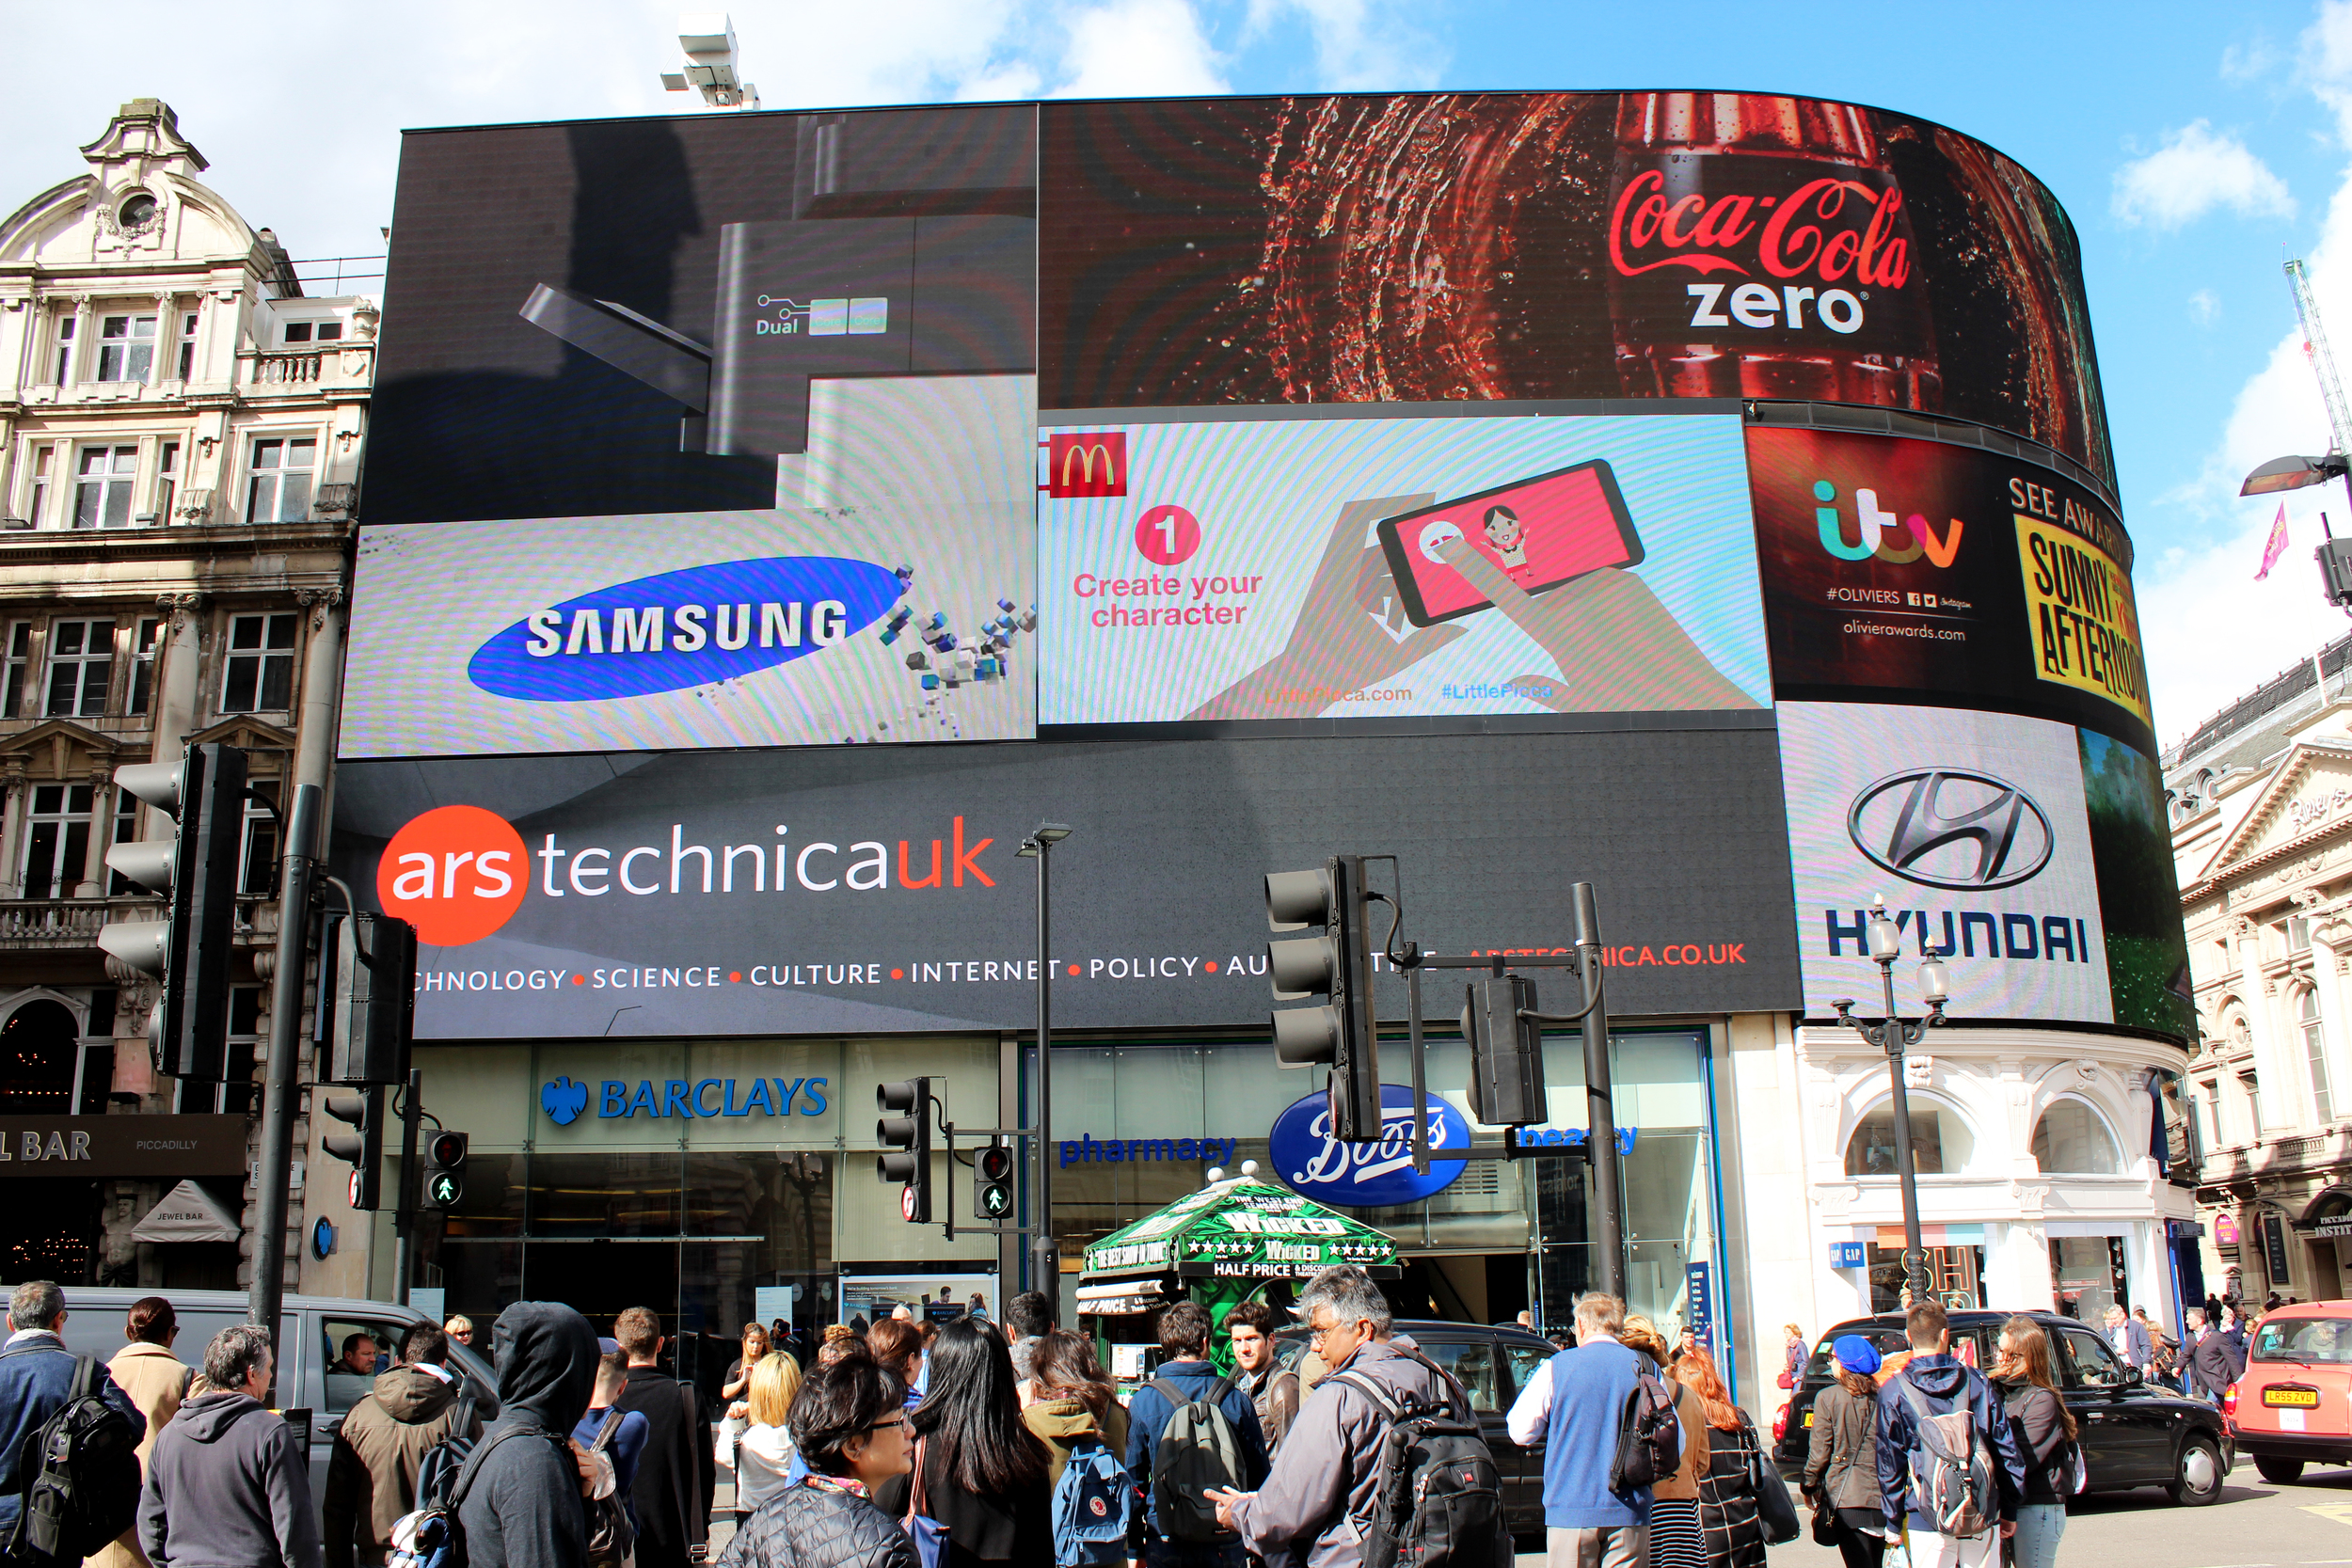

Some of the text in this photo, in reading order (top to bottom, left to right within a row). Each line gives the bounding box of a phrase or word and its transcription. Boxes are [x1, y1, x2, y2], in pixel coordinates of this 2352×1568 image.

[1610, 168, 1910, 290] Coca-Cola
[1687, 283, 1864, 334] zero
[756, 318, 798, 335] Dual
[2009, 477, 2058, 519] SEE
[1154, 515, 1176, 554] 1
[1814, 480, 1963, 568] itv
[1073, 572, 1263, 602] Create your
[2028, 531, 2113, 624] SUNNY
[1826, 587, 1900, 605] #OLIVIERS
[525, 599, 847, 657] SAMSUNG
[1090, 599, 1248, 628] character
[1844, 619, 1966, 641] olivierawards.com
[1441, 683, 1552, 700] #LittlePicca
[391, 847, 513, 900] ars
[592, 966, 722, 990] SCIENCE
[749, 963, 882, 987] CULTURE
[912, 959, 1061, 983] INTERNET
[1089, 956, 1199, 980] POLICY
[597, 1077, 828, 1119] BARCLAYS
[21, 1131, 91, 1161] BAR
[136, 1140, 198, 1150] PICCADILLY
[1059, 1132, 1236, 1169] pharmacy
[1518, 1127, 1638, 1156] beay
[1537, 1172, 1580, 1196] scalator
[1254, 1196, 1282, 1204] WEST
[1283, 1196, 1305, 1205] END
[157, 1212, 203, 1221] JEWEL BAR
[1845, 1248, 1861, 1261] GAP
[1214, 1262, 1249, 1276] HALF
[1252, 1263, 1291, 1277] PRICE
[1076, 1300, 1098, 1314] HALF
[1095, 1298, 1127, 1313] PRICE
[2269, 1392, 2312, 1402] LR55 ZVD
